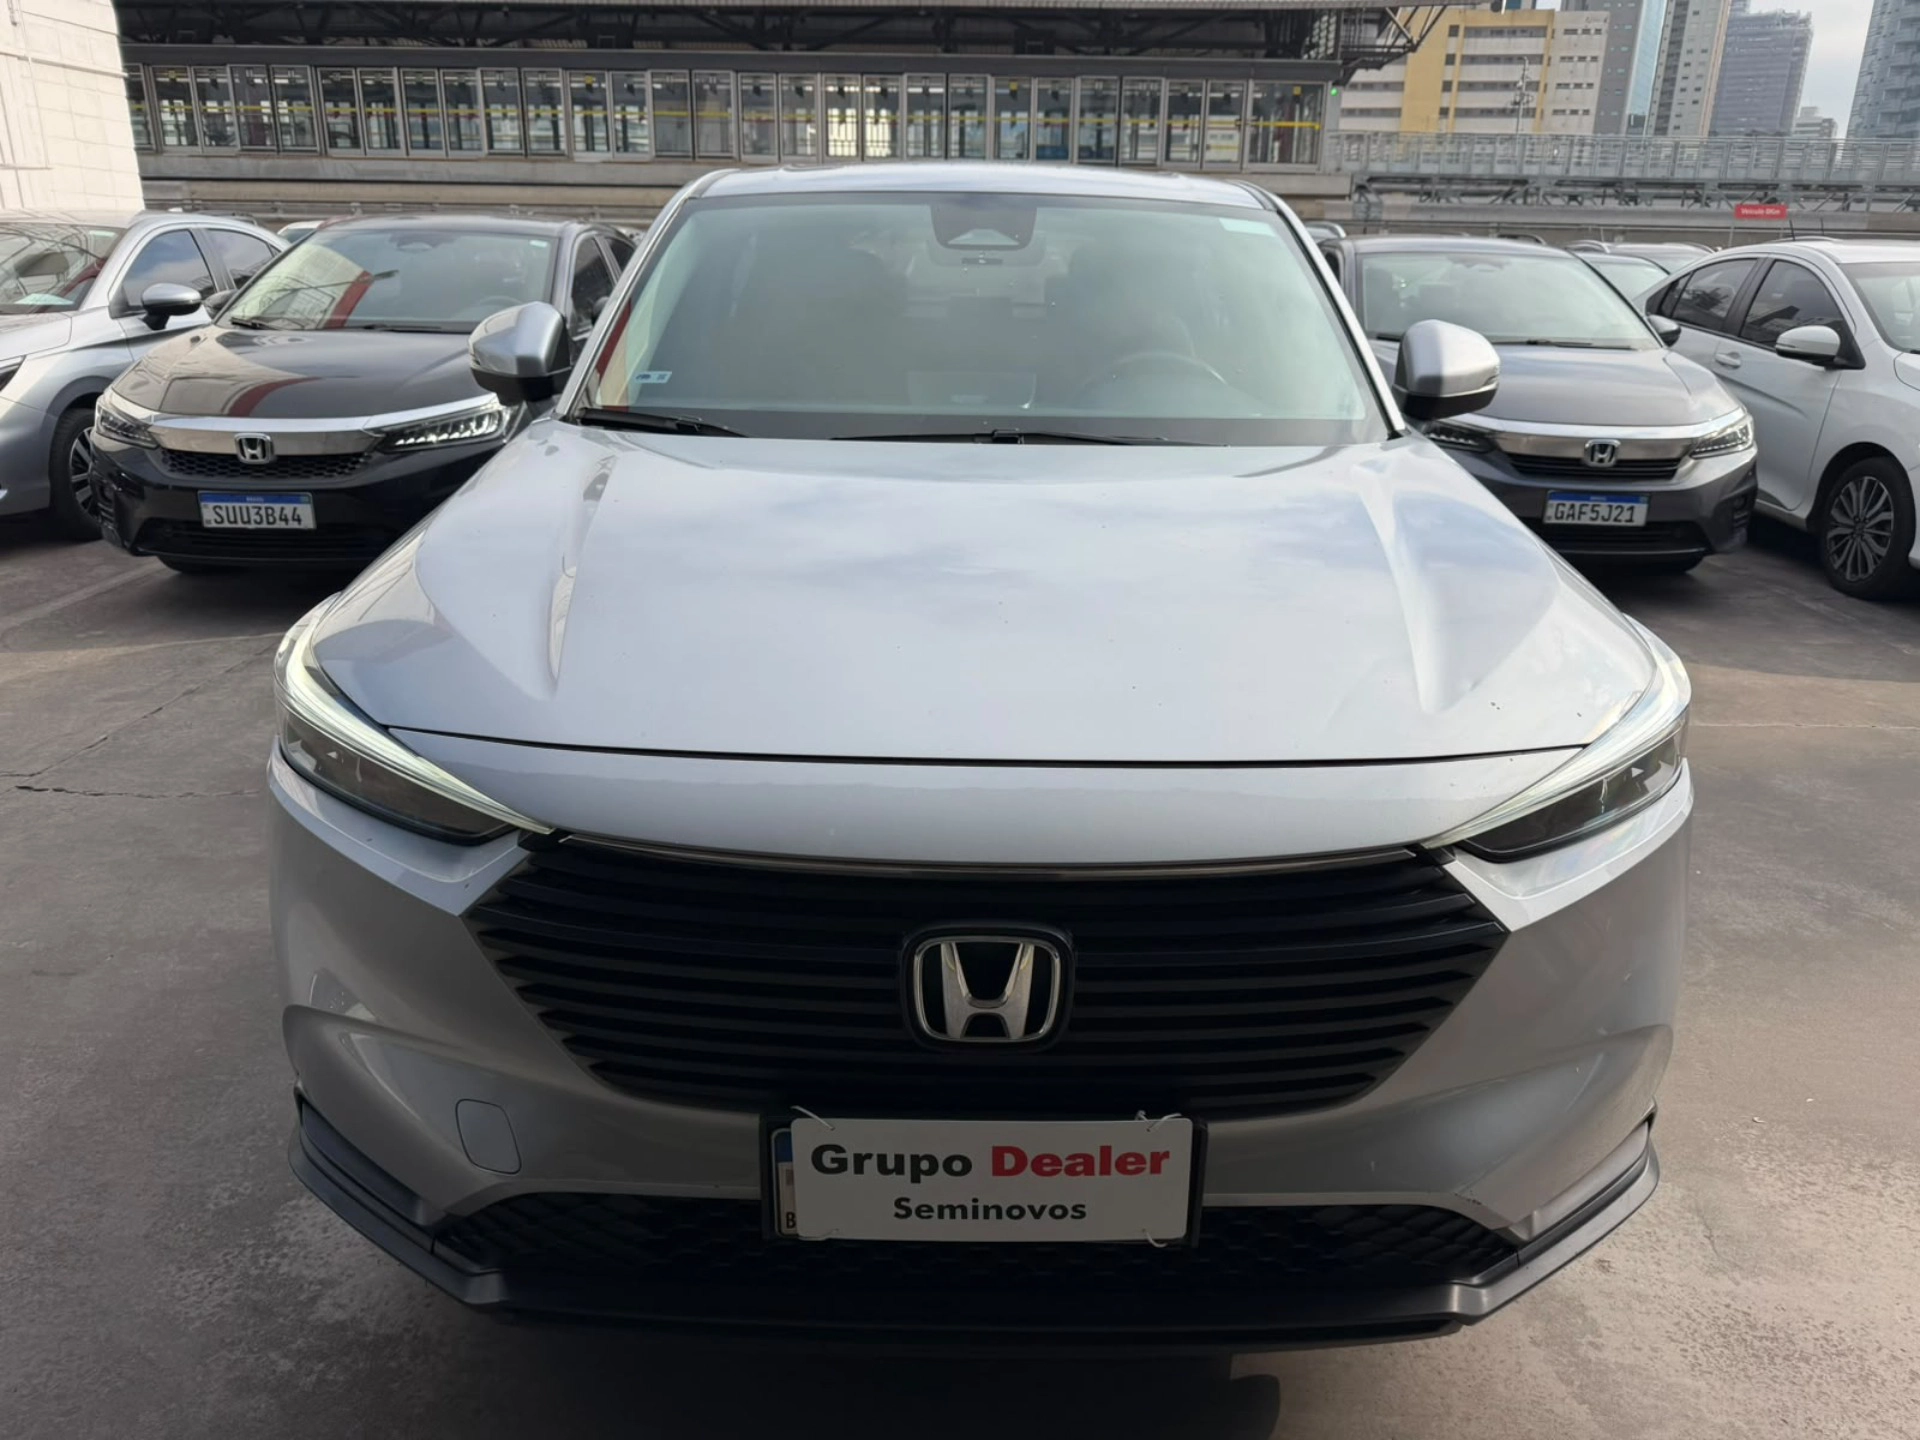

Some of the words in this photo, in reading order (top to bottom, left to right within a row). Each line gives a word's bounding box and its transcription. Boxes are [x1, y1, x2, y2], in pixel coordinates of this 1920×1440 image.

[212, 504, 302, 526] SUU3B44
[1554, 503, 1635, 523] GAF5J21
[810, 1143, 973, 1184] Grupo
[991, 1144, 1170, 1177] Dealer
[893, 1196, 1087, 1221] Seminovos
